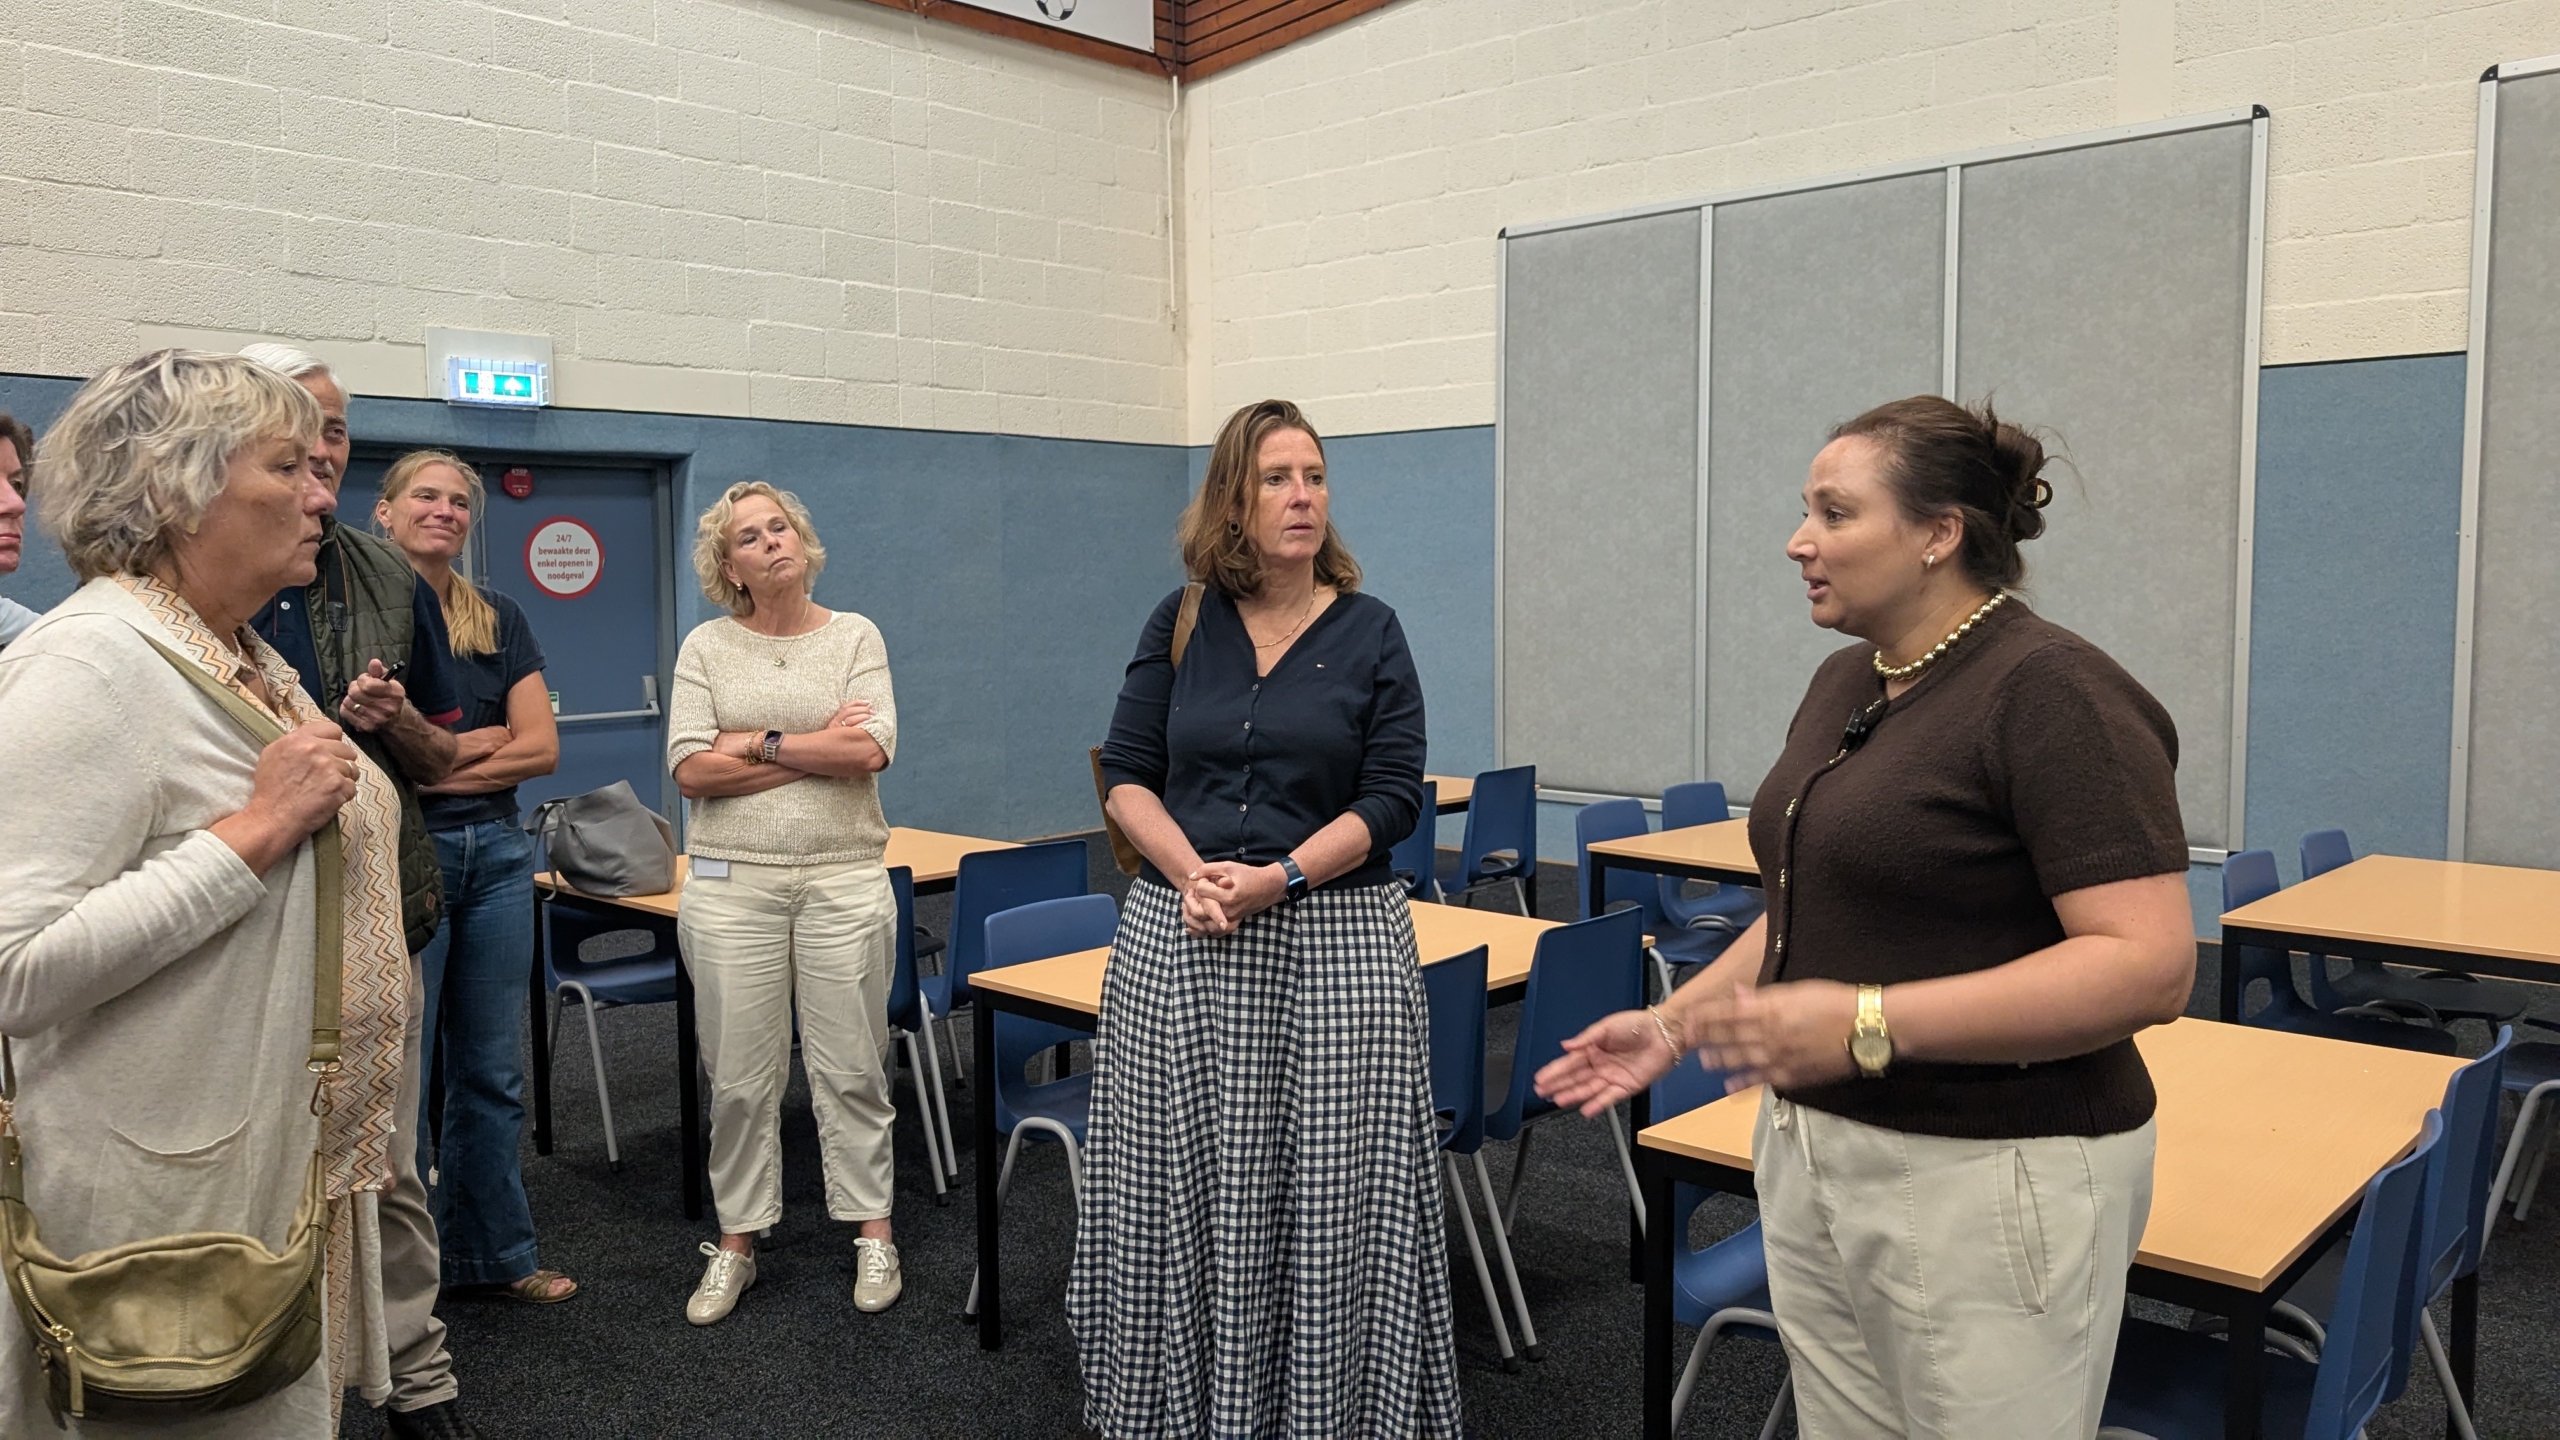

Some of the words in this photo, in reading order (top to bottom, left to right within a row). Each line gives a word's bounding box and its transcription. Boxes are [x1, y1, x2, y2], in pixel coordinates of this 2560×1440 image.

[556, 534, 572, 543] 24/7
[538, 546, 573, 555] bewaakte
[574, 546, 591, 555] deur
[537, 559, 557, 568] enkel
[558, 560, 585, 569] openen
[586, 559, 593, 567] in
[547, 571, 585, 581] noodgeval
